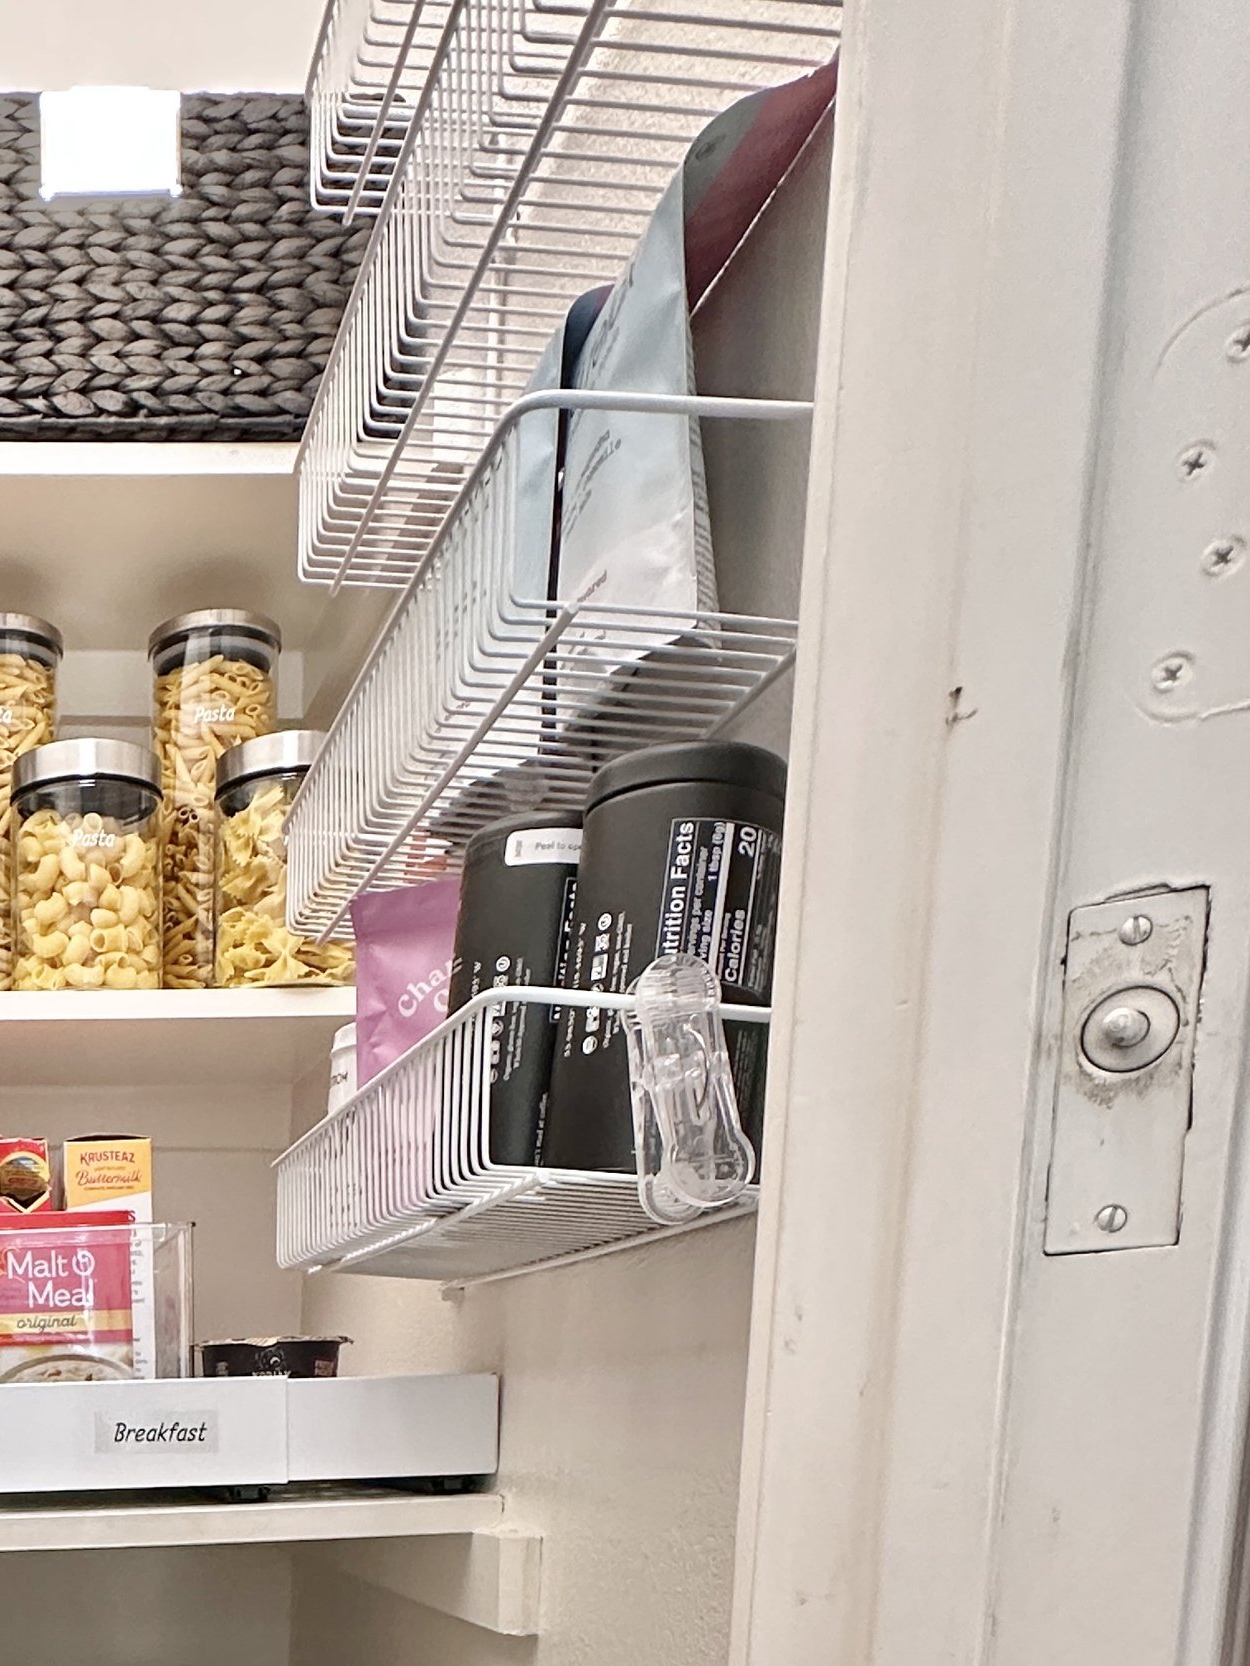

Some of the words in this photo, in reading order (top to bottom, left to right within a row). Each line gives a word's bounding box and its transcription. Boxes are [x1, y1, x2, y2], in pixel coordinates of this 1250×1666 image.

[193, 705, 235, 723] Pasta
[71, 829, 116, 849] Pasta
[670, 821, 694, 880] Facts
[693, 846, 709, 895] container
[701, 909, 713, 932] size
[709, 847, 722, 873] tbsp
[724, 908, 745, 982] Calories
[739, 826, 756, 857] 20
[661, 885, 687, 954] utrition
[690, 897, 703, 915] per
[687, 917, 701, 954] ervings
[80, 1151, 135, 1166] KRUSTEAZ
[75, 1169, 142, 1186] Buttermilk
[6, 1250, 69, 1279] Malt
[28, 1278, 94, 1308] Meal
[17, 1316, 78, 1334] original
[114, 1421, 207, 1443] Breakfast
